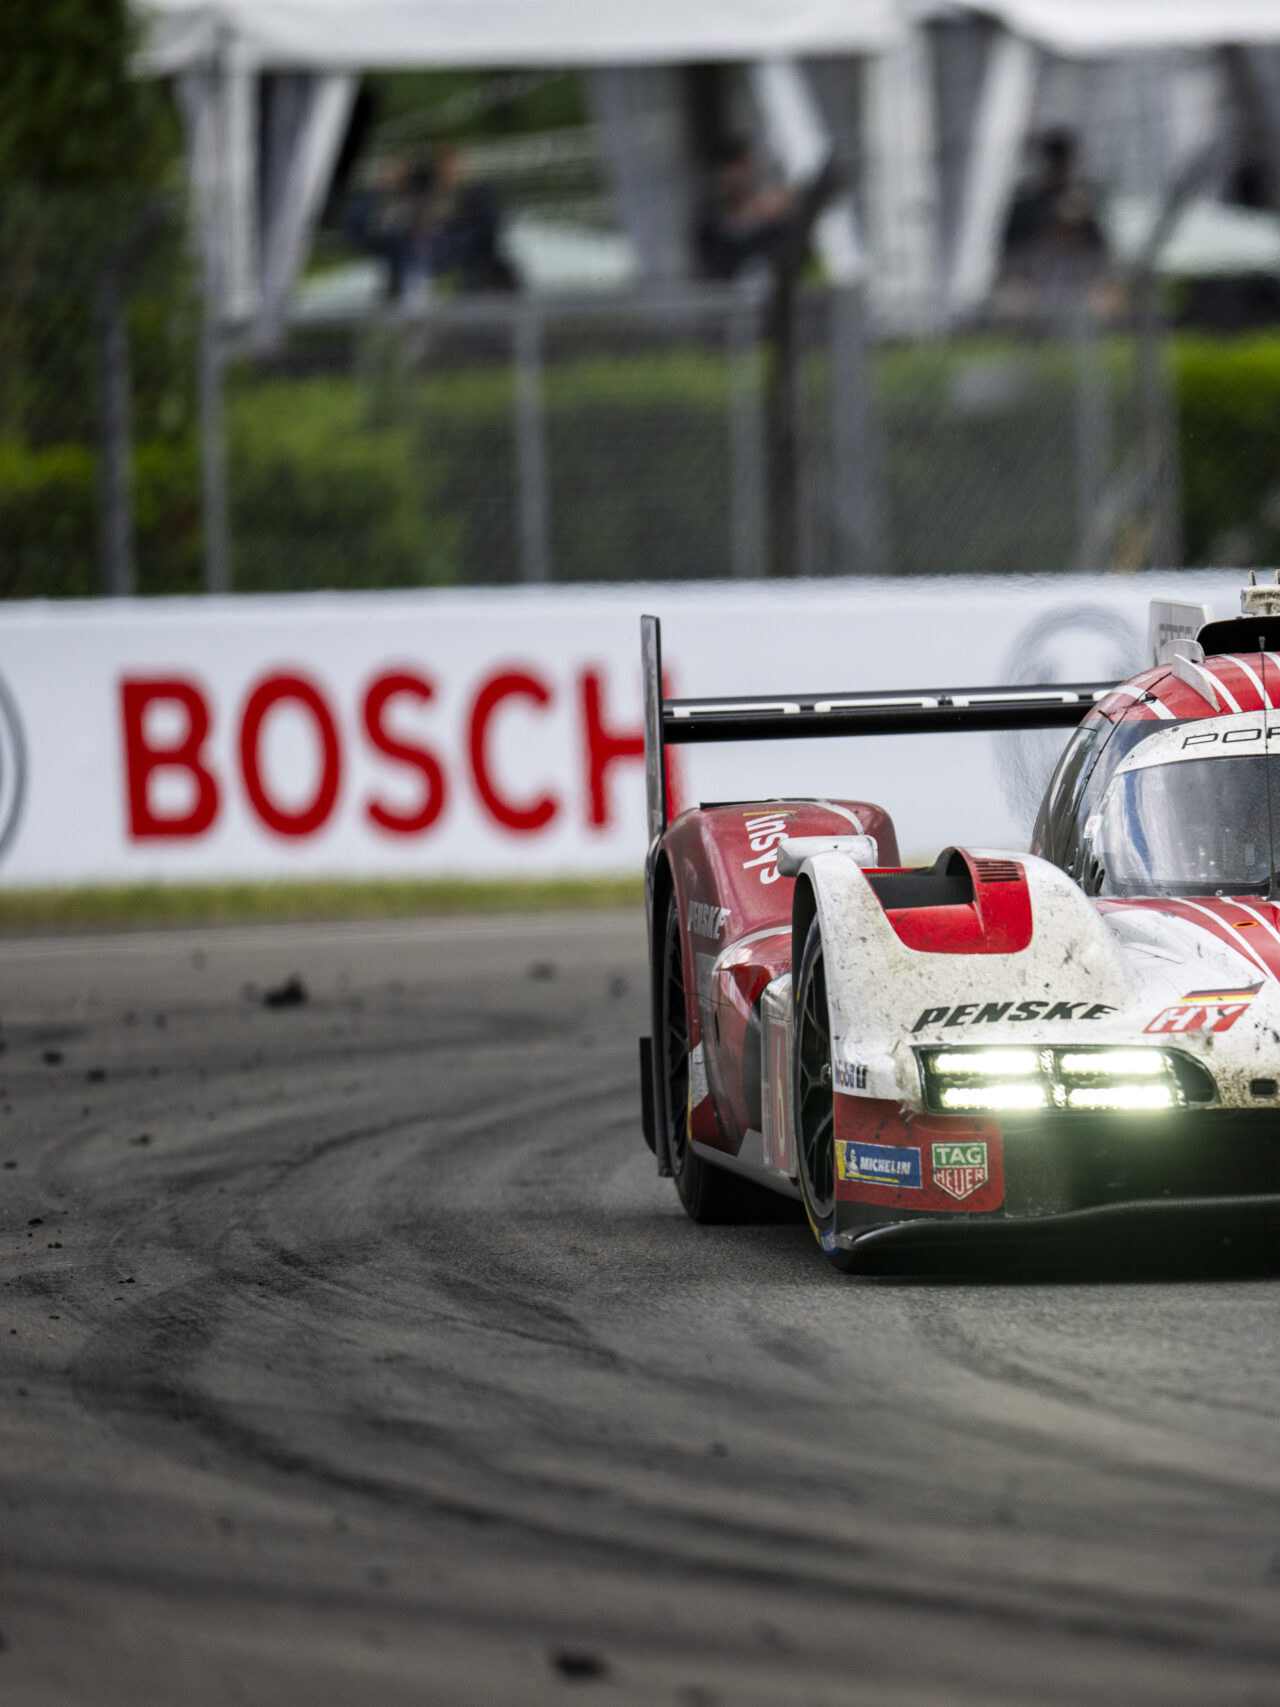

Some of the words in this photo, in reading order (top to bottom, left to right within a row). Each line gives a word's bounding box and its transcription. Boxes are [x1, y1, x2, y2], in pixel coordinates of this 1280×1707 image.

[117, 665, 686, 844] BOSCH
[911, 1000, 1119, 1034] PENSKE
[1147, 1005, 1244, 1032] HY
[859, 1156, 912, 1175] MICHELIN
[935, 1147, 982, 1164] TAG
[936, 1167, 986, 1196] HEUER
